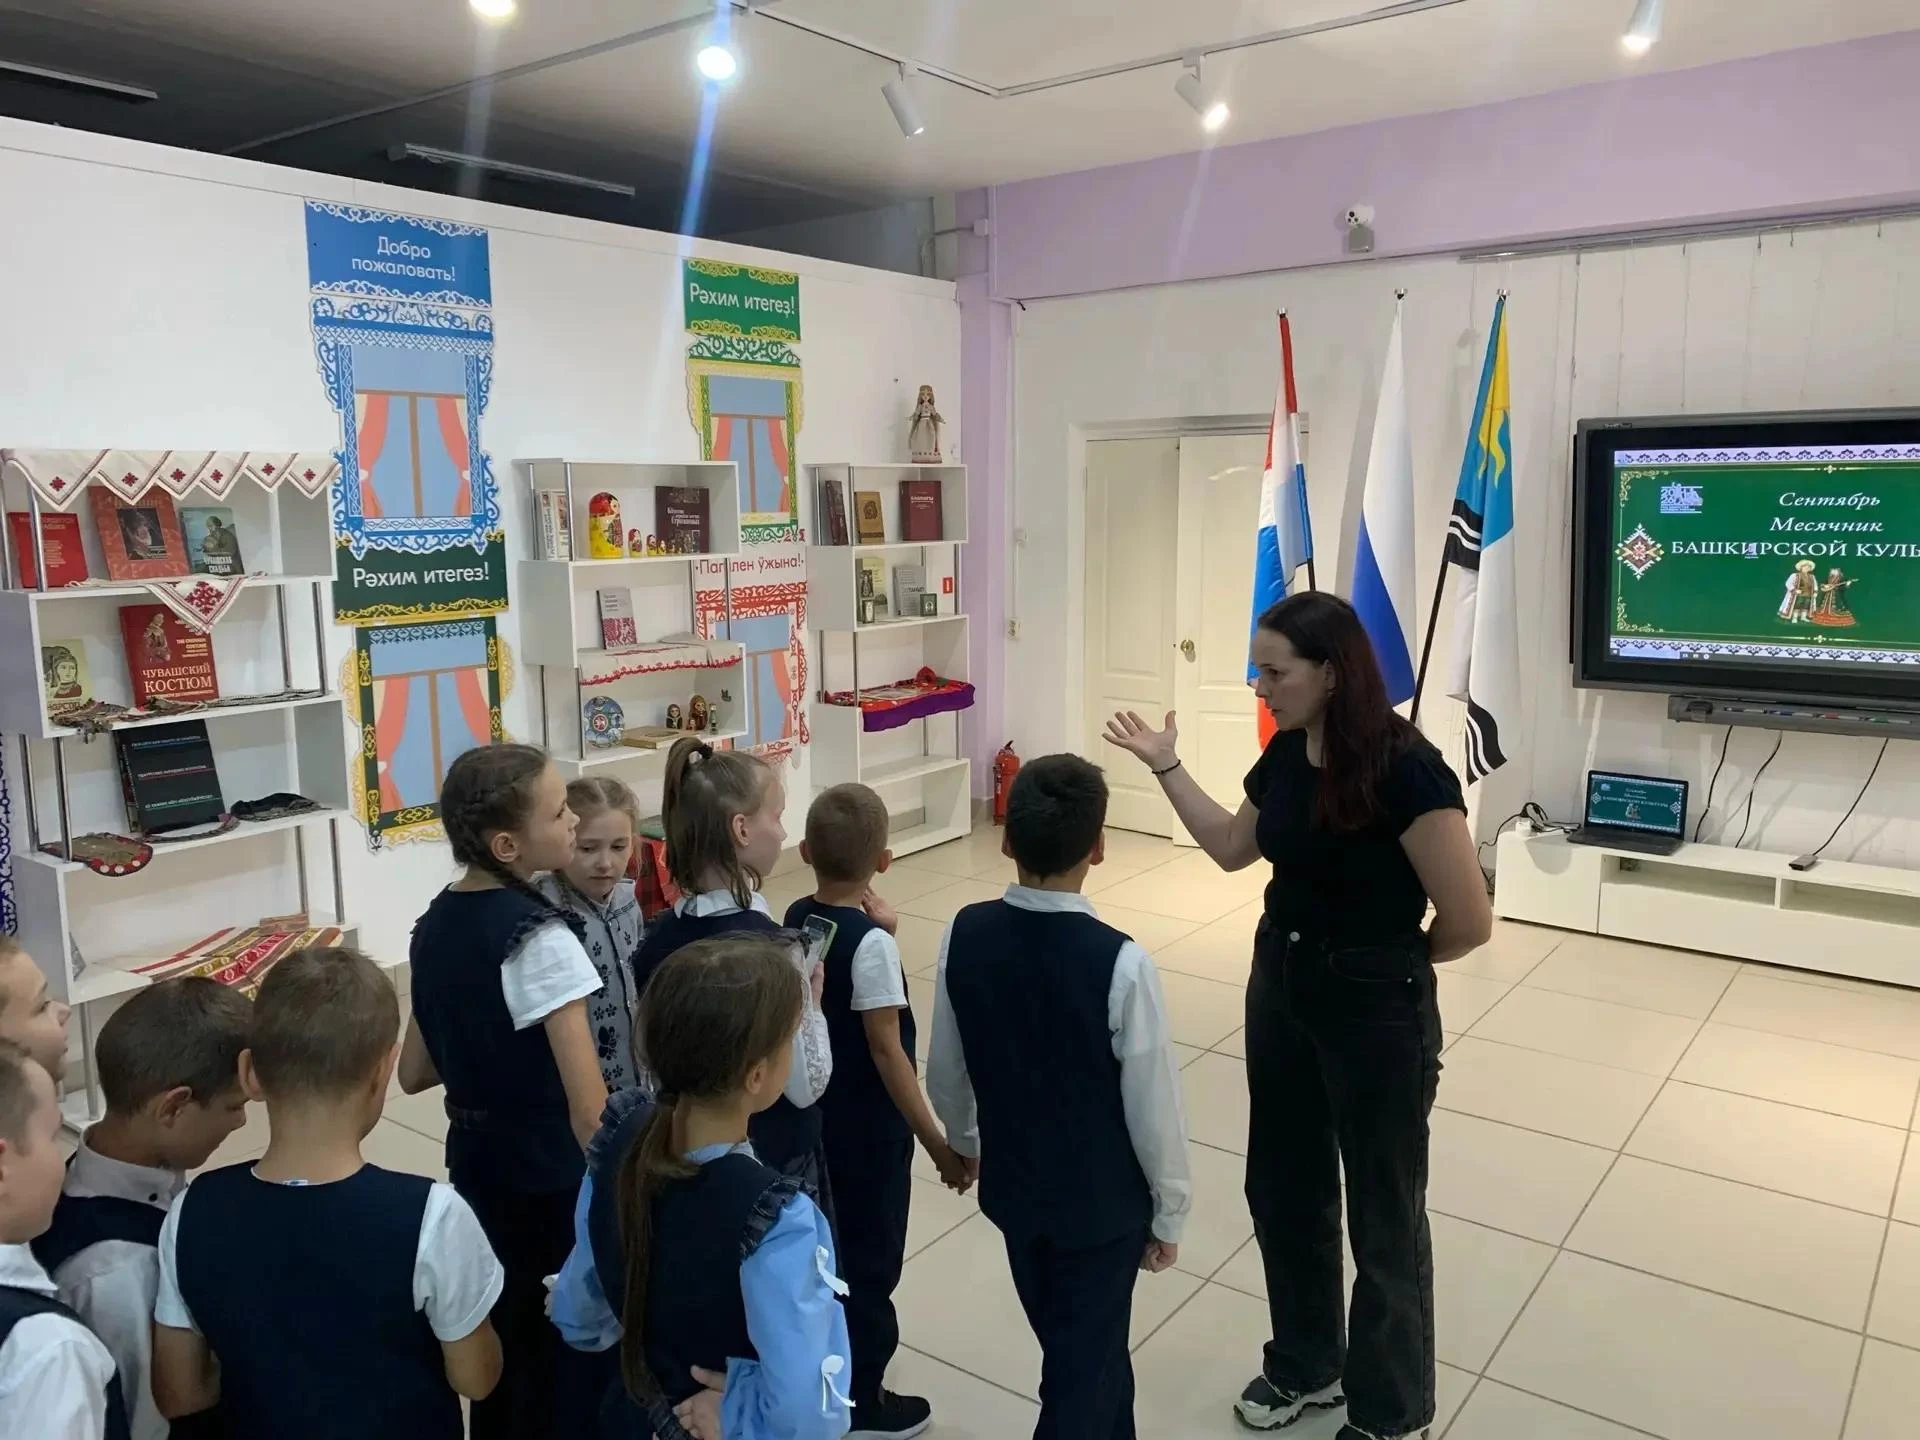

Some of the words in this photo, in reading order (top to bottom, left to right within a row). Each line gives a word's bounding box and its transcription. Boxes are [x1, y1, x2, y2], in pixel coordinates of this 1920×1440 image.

[377, 236, 431, 260] Добро
[351, 257, 456, 282] пожаловать!
[689, 282, 740, 308] Рәхим
[1779, 492, 1881, 511] Сентябрь
[1769, 517, 1885, 532] Месячник
[1671, 540, 1848, 558] БАШКИРСКОЙ
[353, 567, 417, 589] Рәхим
[424, 561, 490, 584] итегез!
[699, 559, 754, 575] Паглен
[142, 662, 211, 679] ЧУВАШСКИЙ
[144, 675, 213, 694] КОСТЮМ
